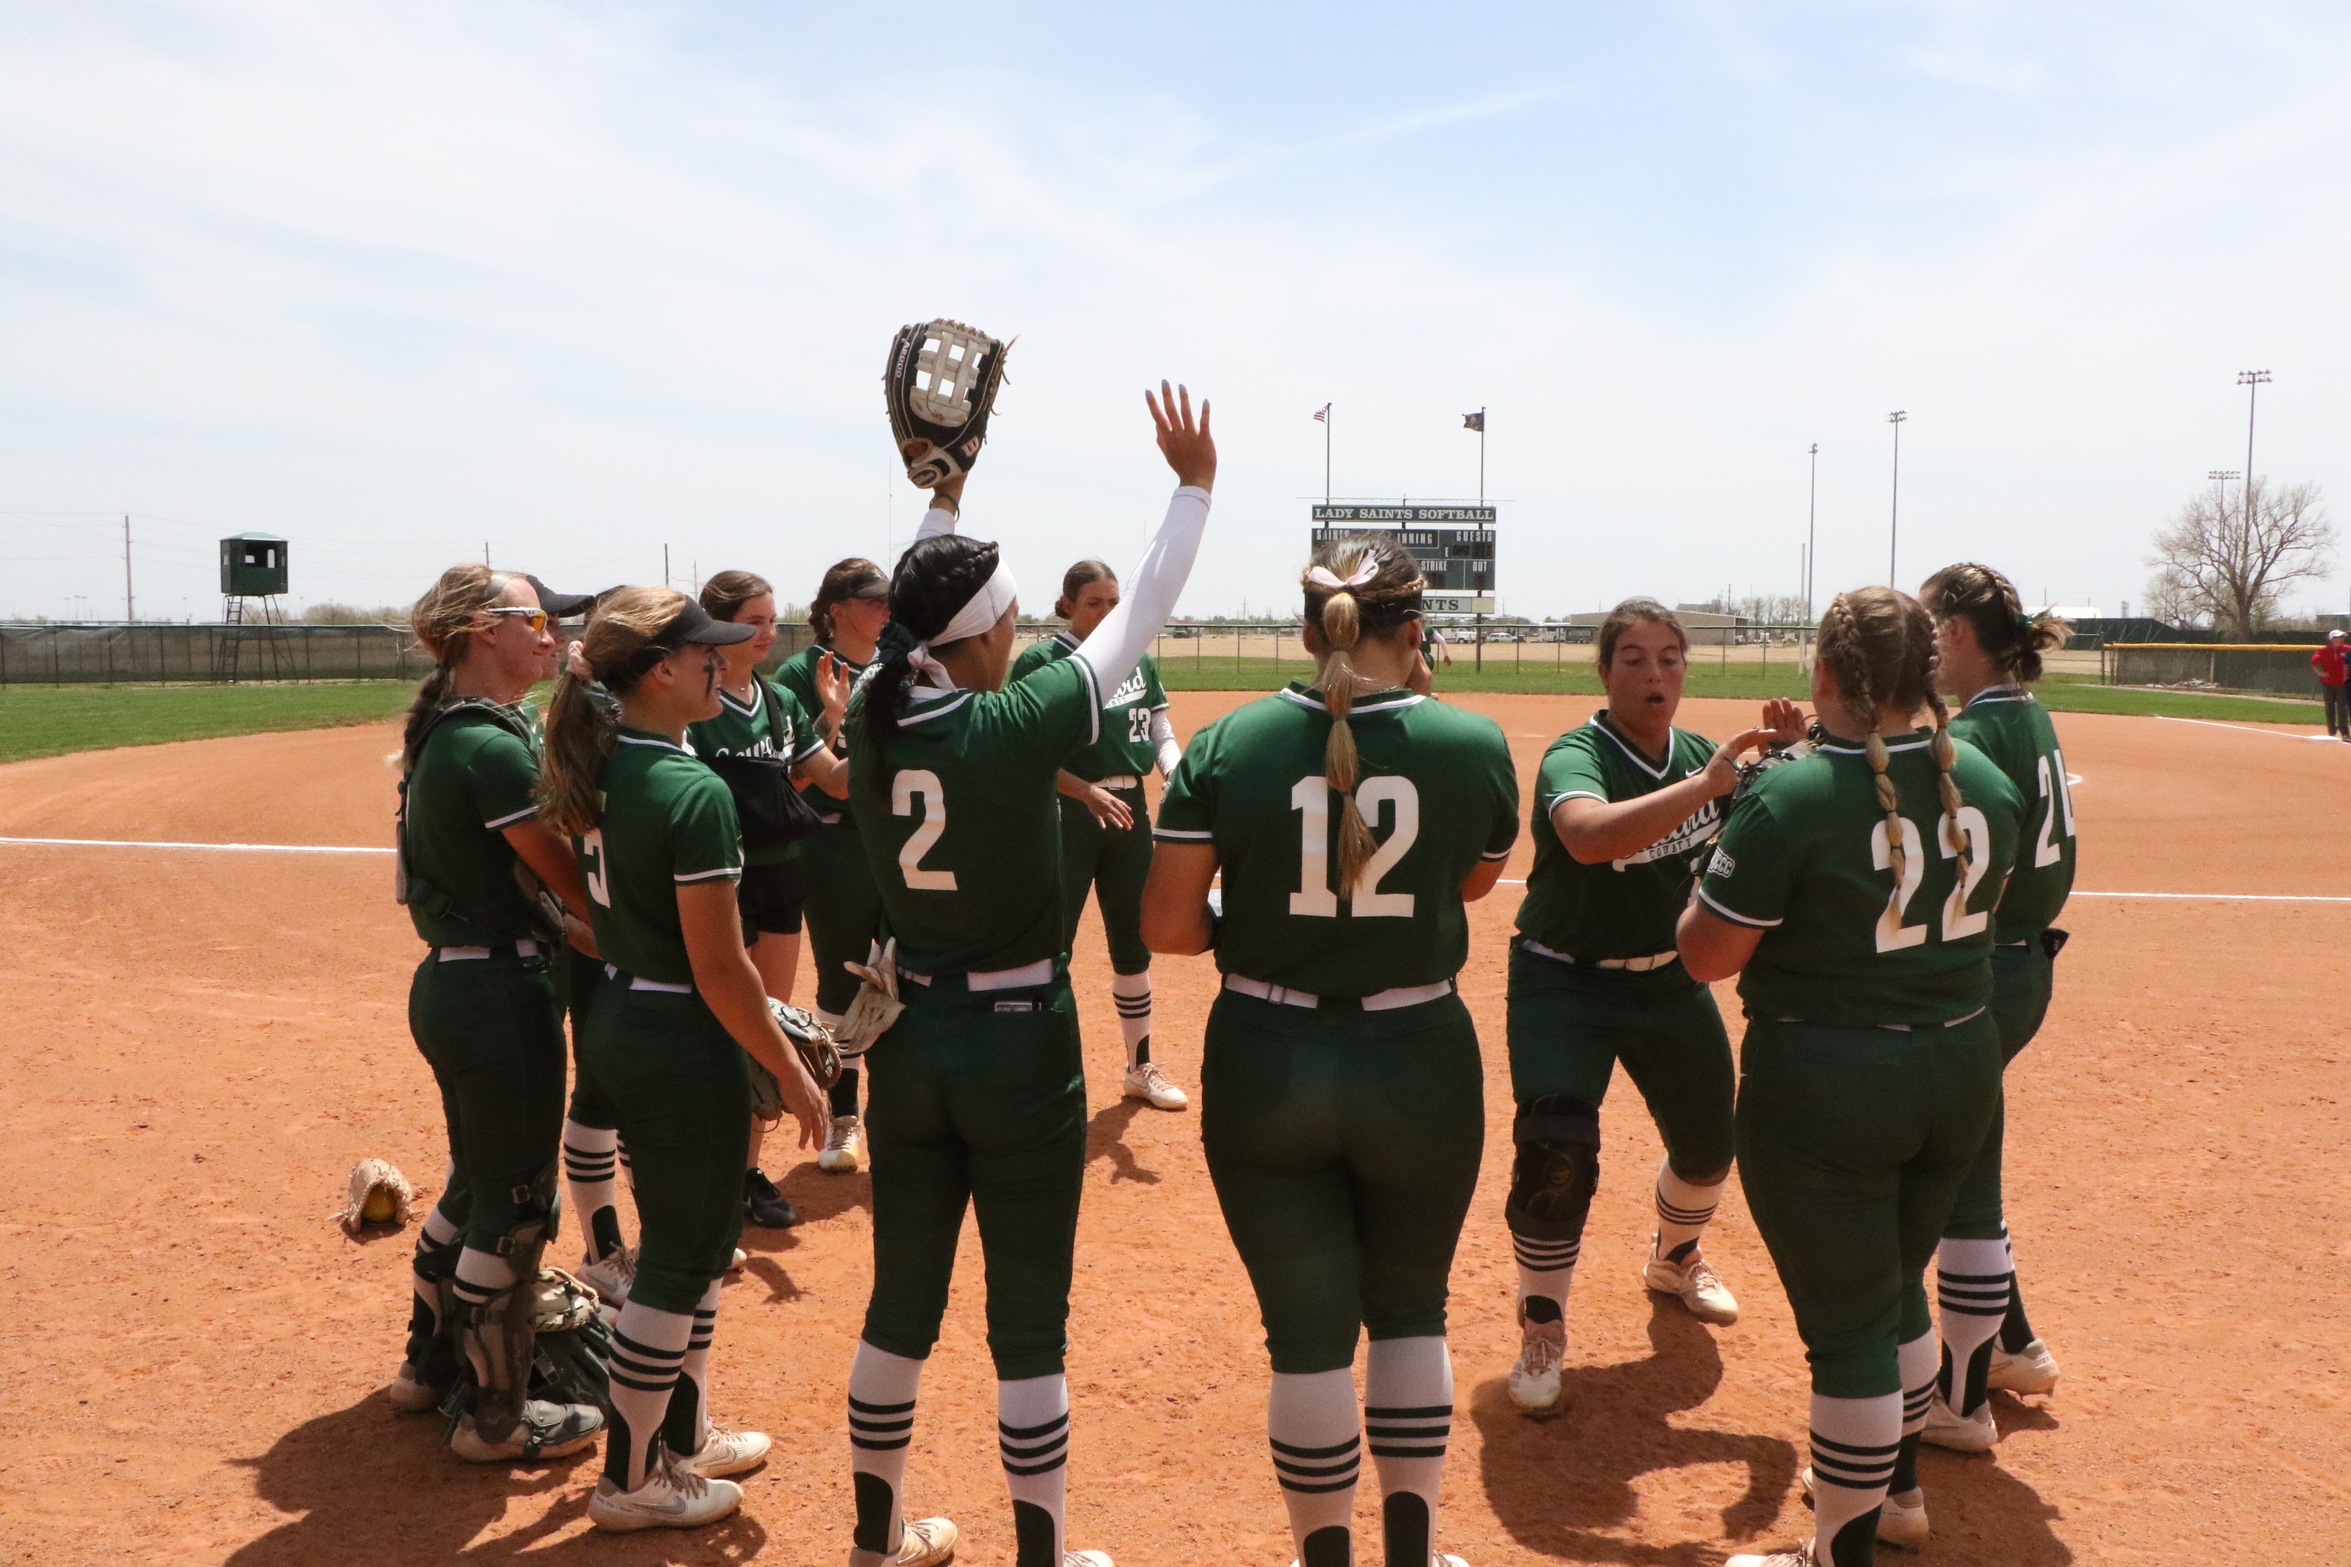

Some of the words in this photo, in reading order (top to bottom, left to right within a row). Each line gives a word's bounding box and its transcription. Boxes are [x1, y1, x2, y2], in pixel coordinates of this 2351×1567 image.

[1315, 508, 1354, 519] LADY
[1359, 509, 1413, 520] SAINTS
[1418, 509, 1494, 520] SOFTBALL
[1397, 532, 1433, 544] INNING
[1456, 530, 1493, 542] GUESTS
[1444, 546, 1449, 558] E
[1420, 560, 1448, 571] STRIKE
[1472, 561, 1487, 572] OUT
[1422, 599, 1459, 611] NTS
[1128, 707, 1152, 743] 23
[891, 769, 959, 891] 2
[1289, 775, 1420, 918] 12
[1871, 806, 1990, 954] 22
